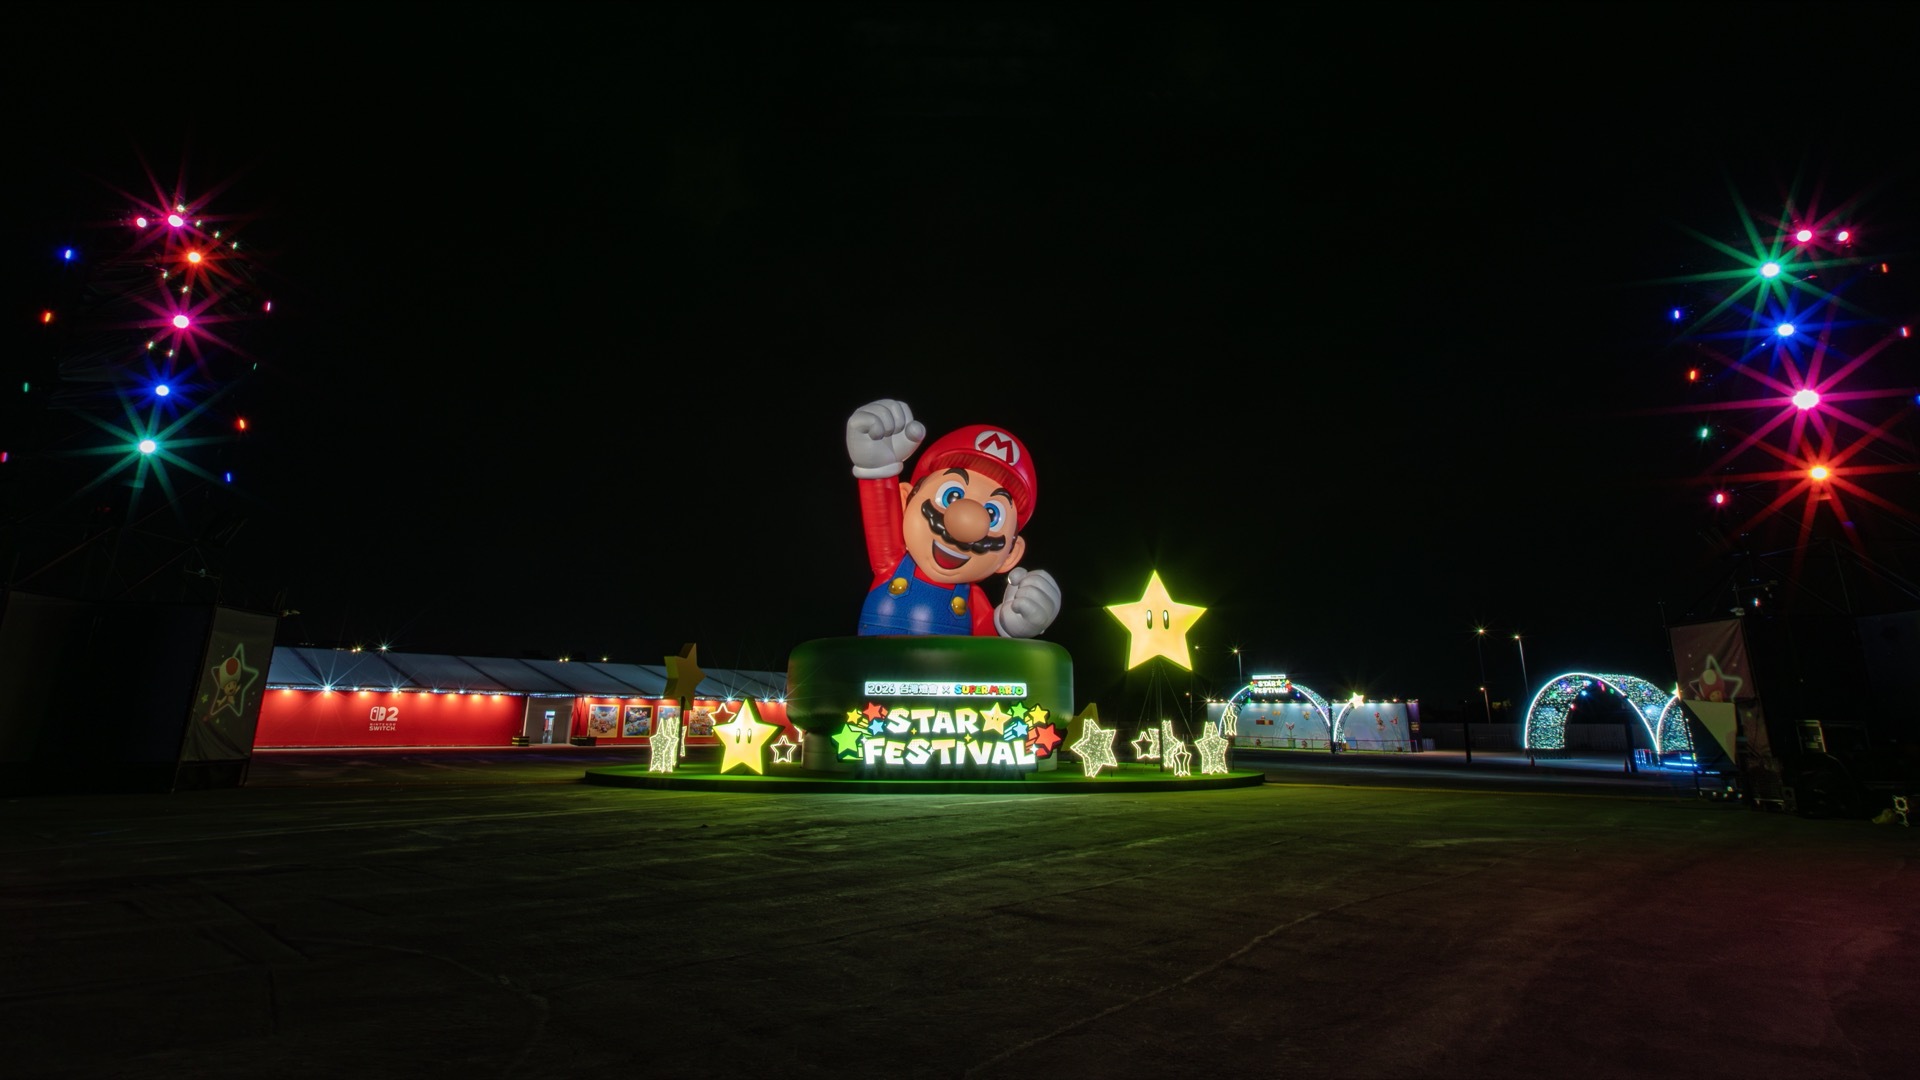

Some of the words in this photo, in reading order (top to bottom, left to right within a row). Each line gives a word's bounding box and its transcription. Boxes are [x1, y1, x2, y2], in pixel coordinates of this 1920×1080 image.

[978, 432, 1014, 464] M
[867, 683, 896, 694] 2026
[954, 684, 988, 695] SUPER
[988, 685, 1024, 695] MARIO
[386, 706, 399, 721] 2
[885, 707, 980, 734] STAR
[864, 737, 1037, 765] FESTIVAL
